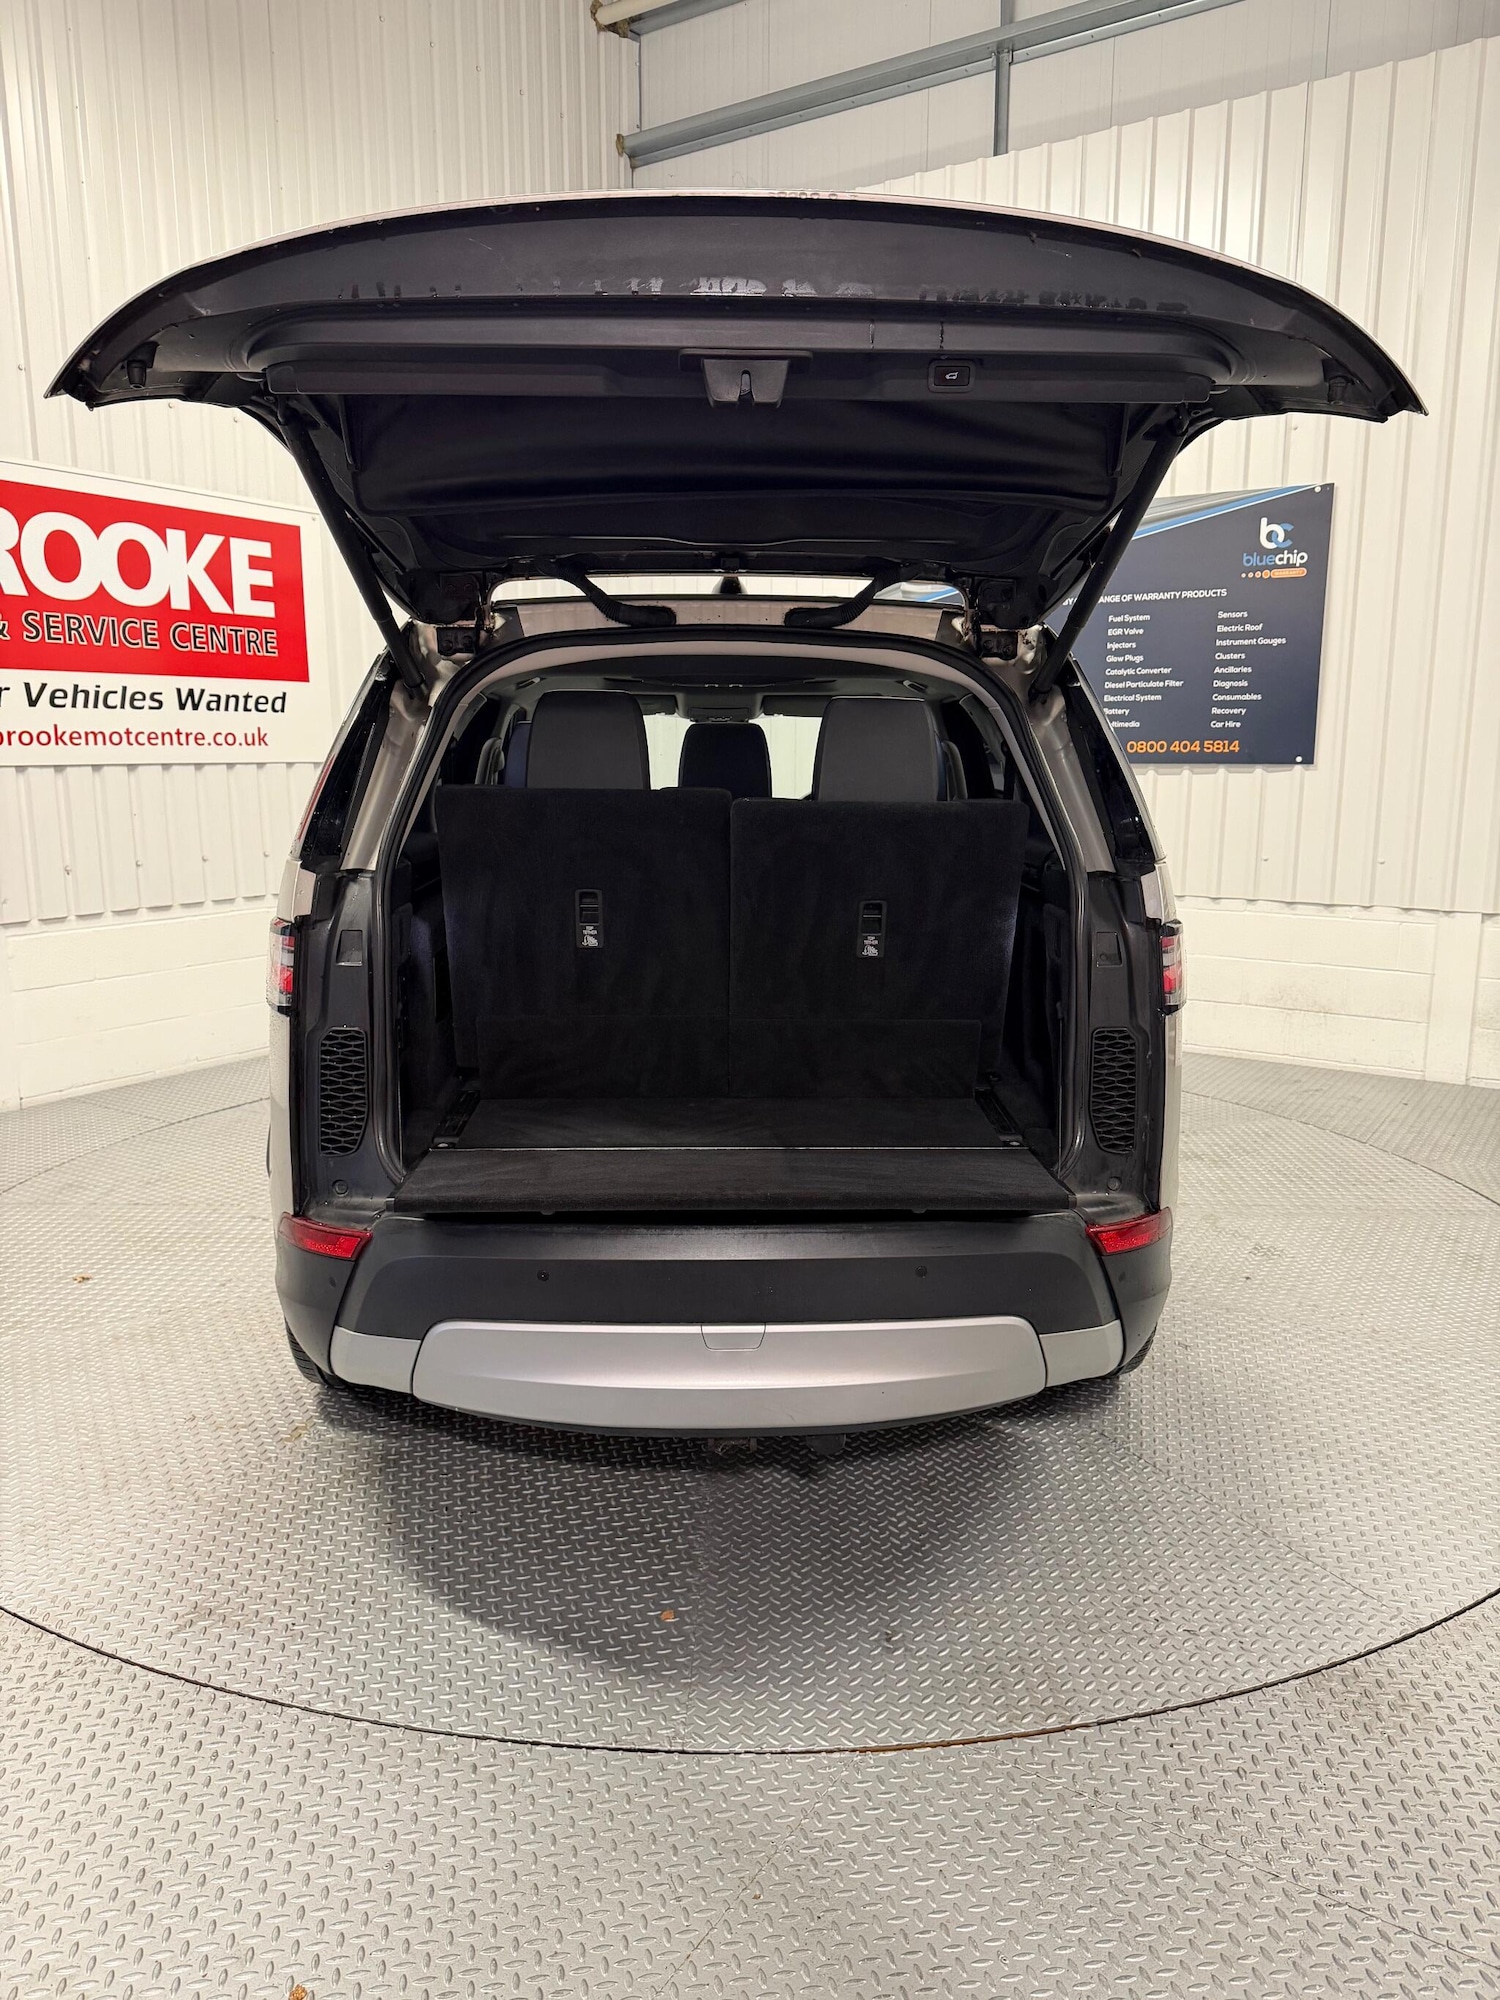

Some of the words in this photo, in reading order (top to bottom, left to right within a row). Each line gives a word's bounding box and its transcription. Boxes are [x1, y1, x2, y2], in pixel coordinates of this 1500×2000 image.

[1242, 549, 1309, 567] bluechip
[1098, 594, 1120, 604] ANGE
[1121, 593, 1133, 602] OF
[1133, 591, 1181, 602] WARRANTY
[1181, 588, 1228, 599] PRODUCTS
[1108, 615, 1123, 623] Fuel
[1124, 613, 1151, 623] System
[1217, 610, 1248, 619] Sensors
[1107, 628, 1122, 636] EGR
[1123, 627, 1144, 635] Valve
[1216, 624, 1244, 633] Electric
[1244, 623, 1263, 631] Roof
[23, 610, 160, 649] SERVICE
[170, 622, 278, 657] CENTRE
[1106, 641, 1137, 651] Injectors
[1215, 638, 1257, 647] Instrument
[1257, 636, 1287, 647] Gauges
[1106, 655, 1124, 663] Glow
[1124, 654, 1144, 664] Plugs
[1214, 652, 1246, 661] Clusters
[1105, 668, 1136, 677] Catalytic
[1136, 666, 1172, 675] Converter
[1213, 665, 1252, 674] Ancillaries
[1104, 681, 1126, 689] Diesel
[1125, 680, 1165, 688] Particulate
[1212, 679, 1248, 689] Diagnosis
[23, 682, 164, 711] Vehicles
[175, 687, 287, 713] Wanted
[1103, 694, 1135, 702] Electrical
[1135, 694, 1162, 703] System
[1212, 692, 1262, 701] Consumables
[1211, 706, 1246, 716] Recovery
[1224, 720, 1241, 728] Hire
[1126, 740, 1167, 753] 0800
[1169, 740, 1200, 753] 404
[1203, 740, 1240, 753] 5814
